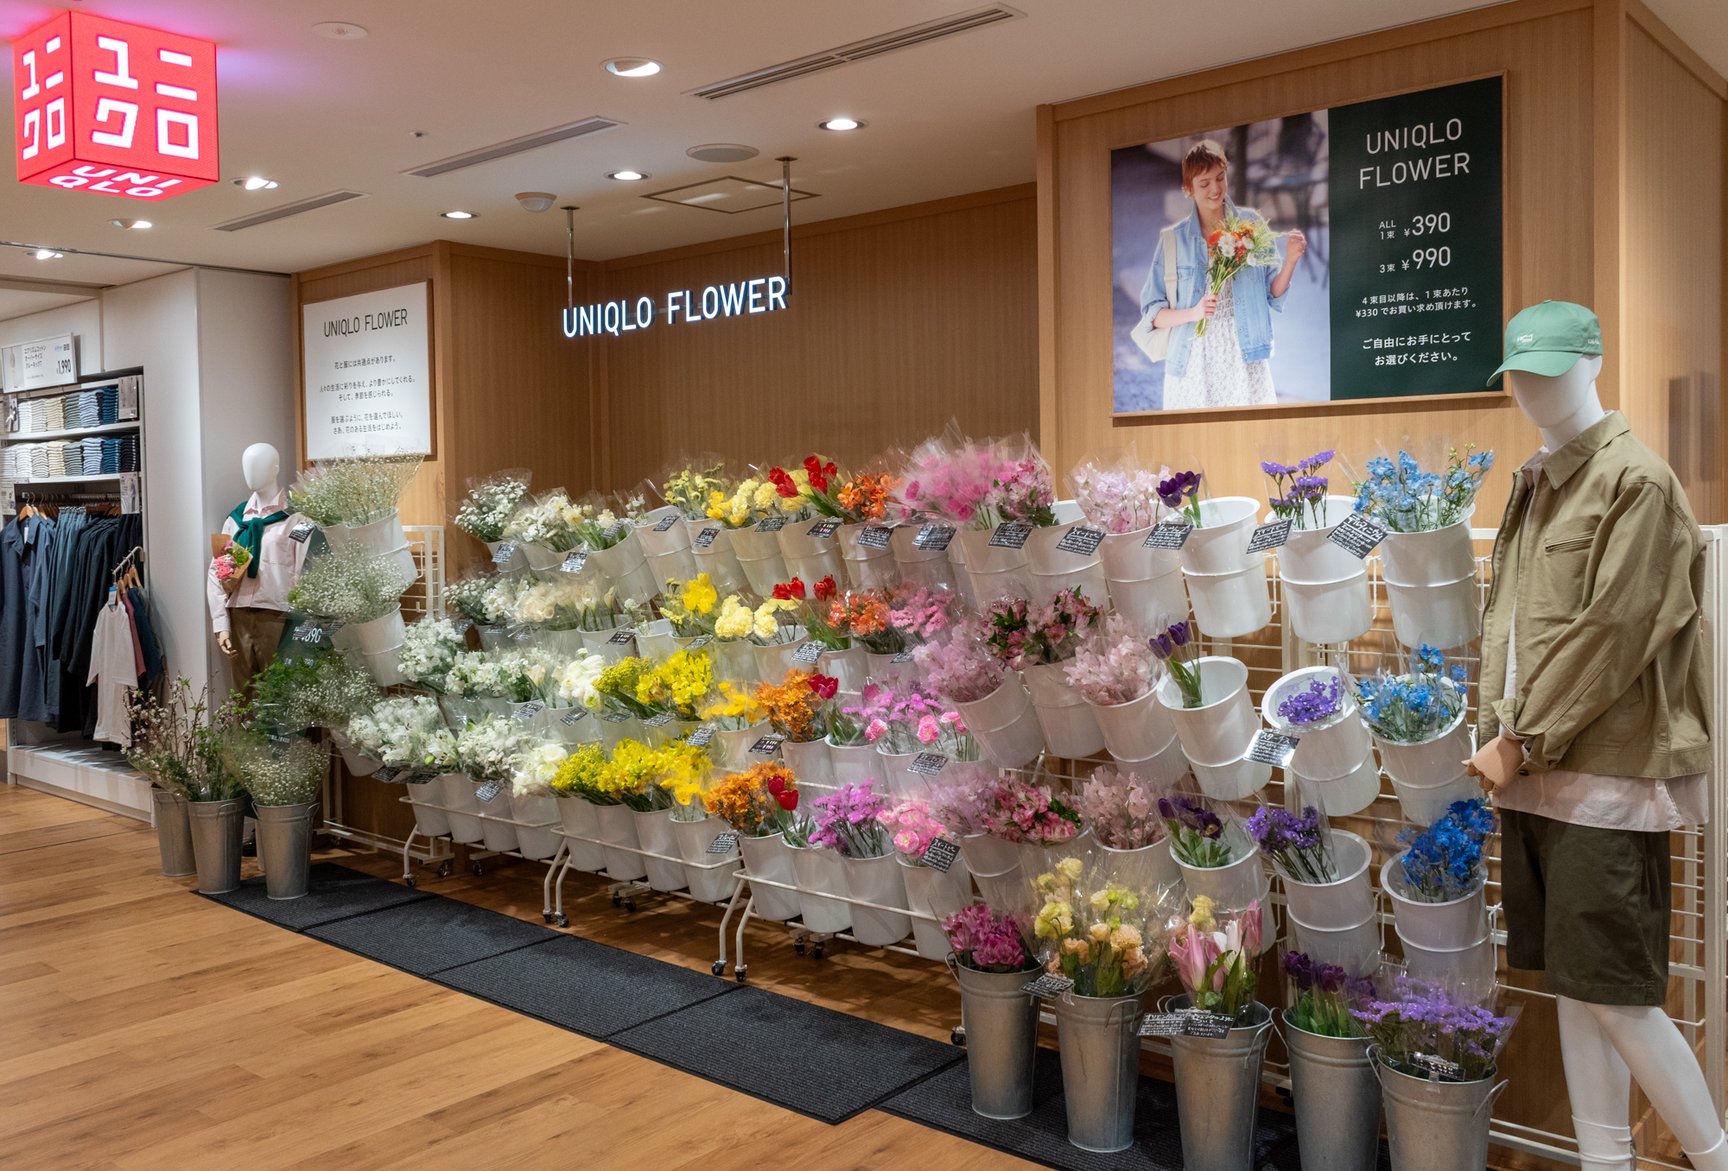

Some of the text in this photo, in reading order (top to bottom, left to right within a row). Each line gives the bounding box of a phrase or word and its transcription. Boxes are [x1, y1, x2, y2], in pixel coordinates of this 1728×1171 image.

[1366, 118, 1462, 155] UNIQLO
[71, 165, 183, 189] UNI
[1359, 152, 1470, 190] FLOWER
[48, 175, 164, 197] QLO
[1379, 220, 1397, 230] ALL
[1380, 211, 1451, 240] 1束 ¥390
[1379, 246, 1451, 274] 3束 ¥990
[562, 275, 787, 338] UNIQLO FLOWER
[323, 308, 408, 338] UNIQLO FLOWER
[1362, 331, 1472, 350] ご自由にお手にとって
[1374, 351, 1458, 366] お選びください。
